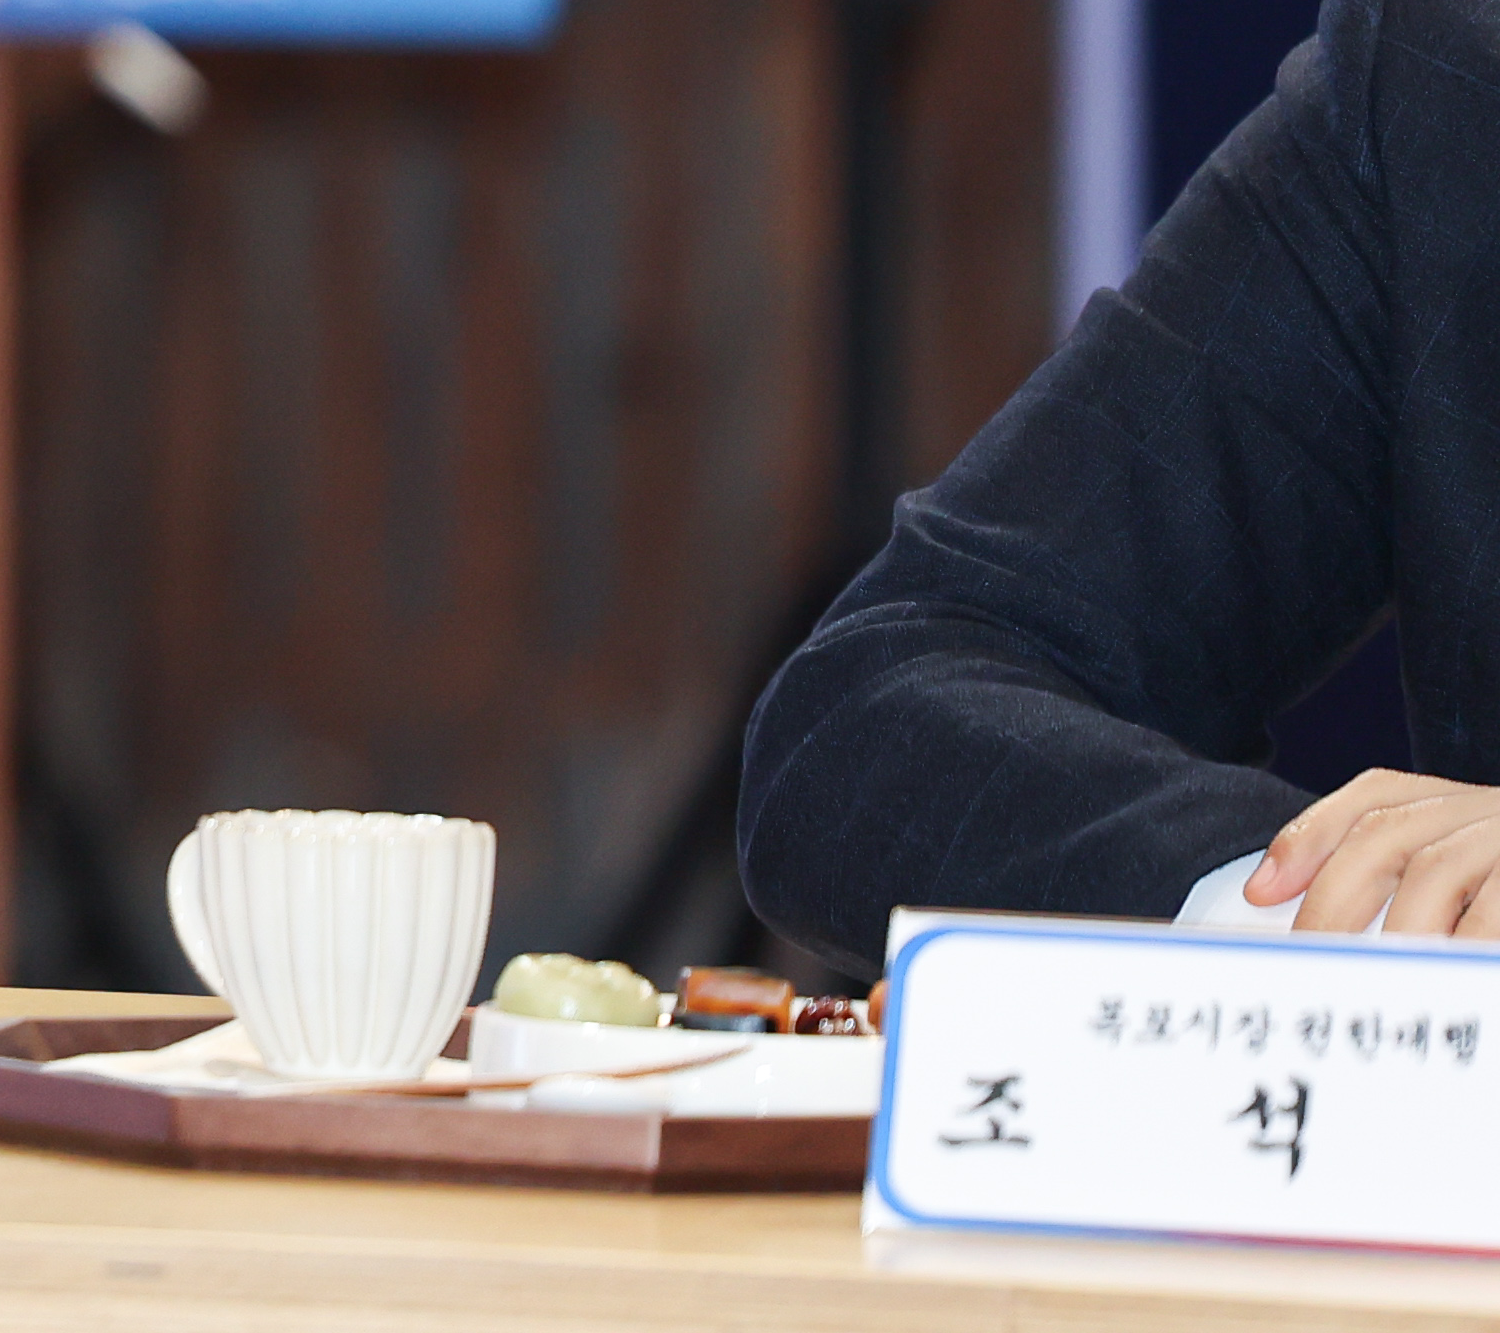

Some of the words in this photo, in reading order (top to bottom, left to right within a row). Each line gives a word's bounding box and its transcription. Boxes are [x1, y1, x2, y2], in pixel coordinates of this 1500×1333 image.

[1090, 998, 1271, 1054] 목포시장
[936, 1073, 1033, 1148] 조
[1228, 1076, 1311, 1183] 석
